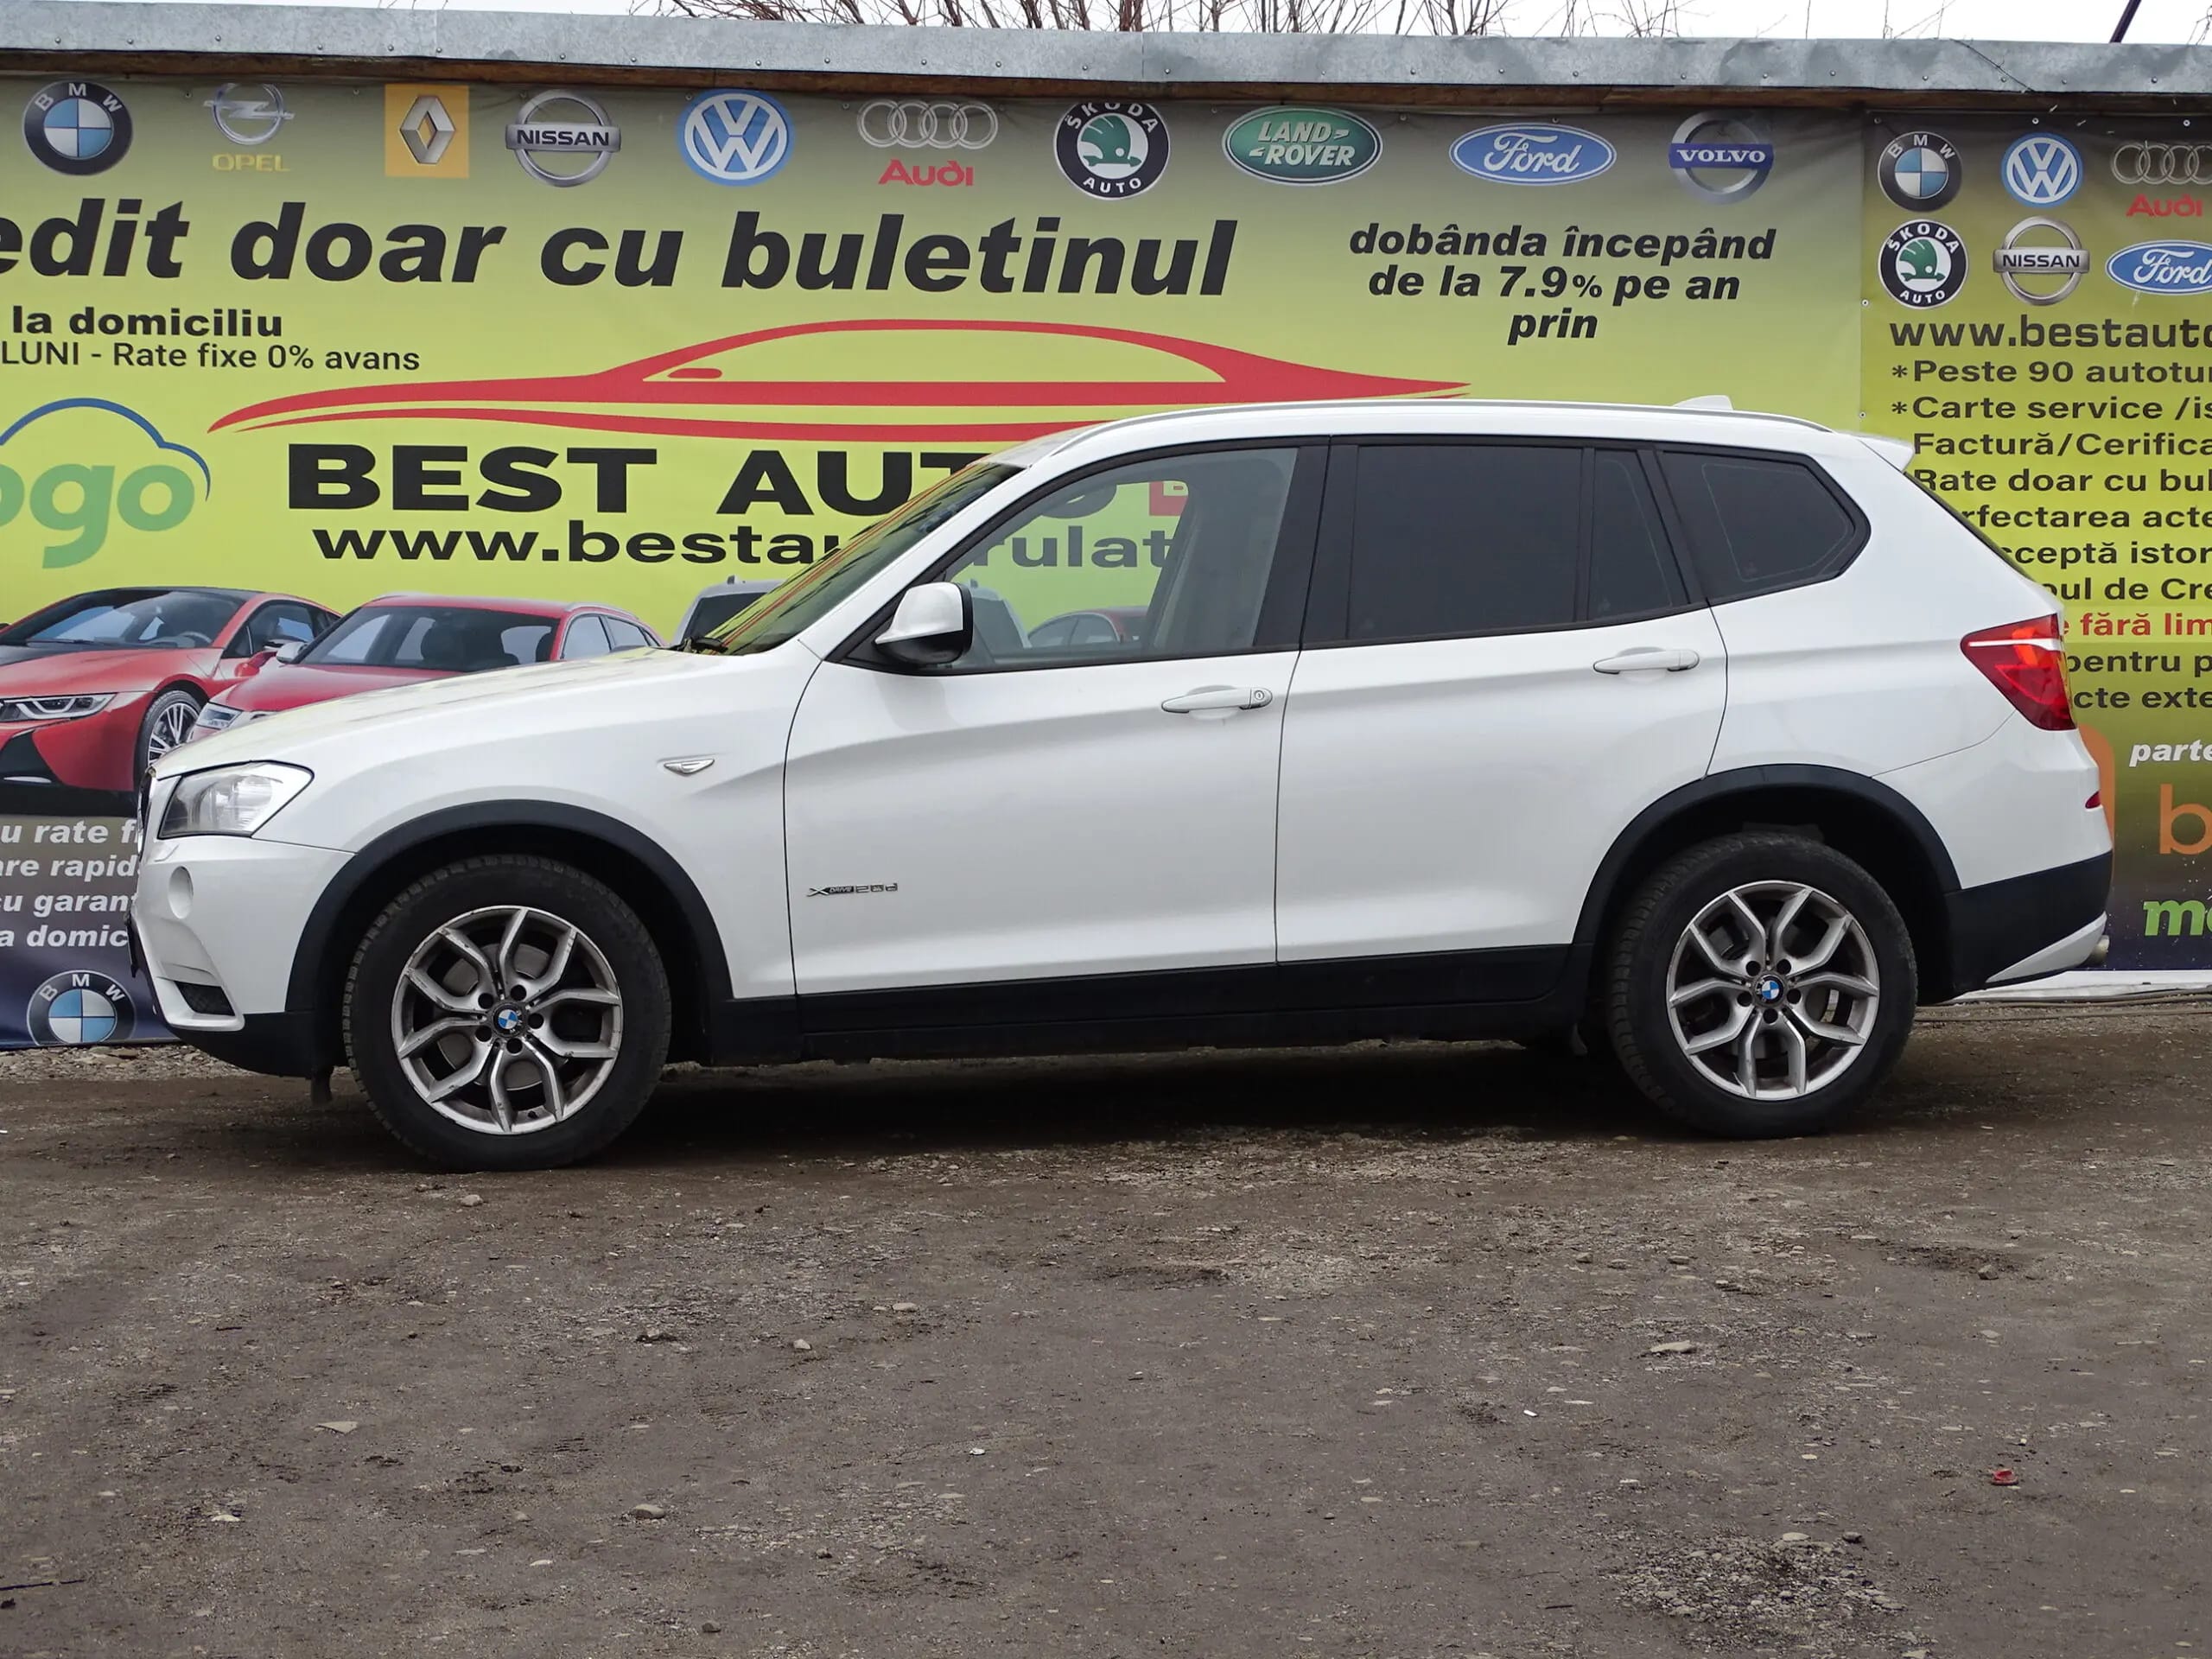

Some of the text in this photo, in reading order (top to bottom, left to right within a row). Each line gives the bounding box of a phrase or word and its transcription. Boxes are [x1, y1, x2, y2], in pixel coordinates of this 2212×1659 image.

[35, 83, 123, 111] BMW
[517, 130, 609, 146] NISSAN
[1257, 122, 1335, 144] LAND
[1264, 144, 1355, 167] ROVER
[1484, 132, 1583, 175] Ford
[1676, 149, 1766, 163] VOLVO
[1887, 134, 1955, 159] BMW
[212, 155, 291, 172] OPEL
[878, 158, 975, 188] Audi
[1083, 176, 1141, 194] AUTO
[2126, 193, 2203, 218] Audi
[230, 201, 508, 284] doar
[540, 226, 683, 287] cu
[721, 211, 1238, 296] buletinul
[1349, 223, 1777, 267] dobânda începând
[2002, 254, 2080, 268] NISSAN
[2133, 248, 2212, 285] Ford
[1368, 264, 1740, 307] de la 7.9% pe an
[1899, 289, 1946, 304] AUTO
[13, 305, 283, 337] la domiciliu
[1508, 308, 1599, 346] prin
[1, 340, 79, 365] LUNI
[113, 342, 188, 367] Rate
[197, 342, 257, 369] fixe
[268, 344, 315, 370] 0%
[324, 348, 421, 371] avans
[2029, 360, 2074, 383] 90
[2085, 361, 2212, 383] autotu
[2027, 396, 2164, 419] service
[288, 442, 658, 514] BEST
[1914, 468, 1997, 492] Rate
[2008, 468, 2093, 492] doar
[2103, 474, 2147, 492] cu
[2130, 541, 2212, 563] istor
[2104, 577, 2150, 601] de
[2081, 613, 2152, 636] fără
[34, 819, 109, 844] rate
[26, 925, 129, 948] domic
[40, 973, 125, 1002] BMW
